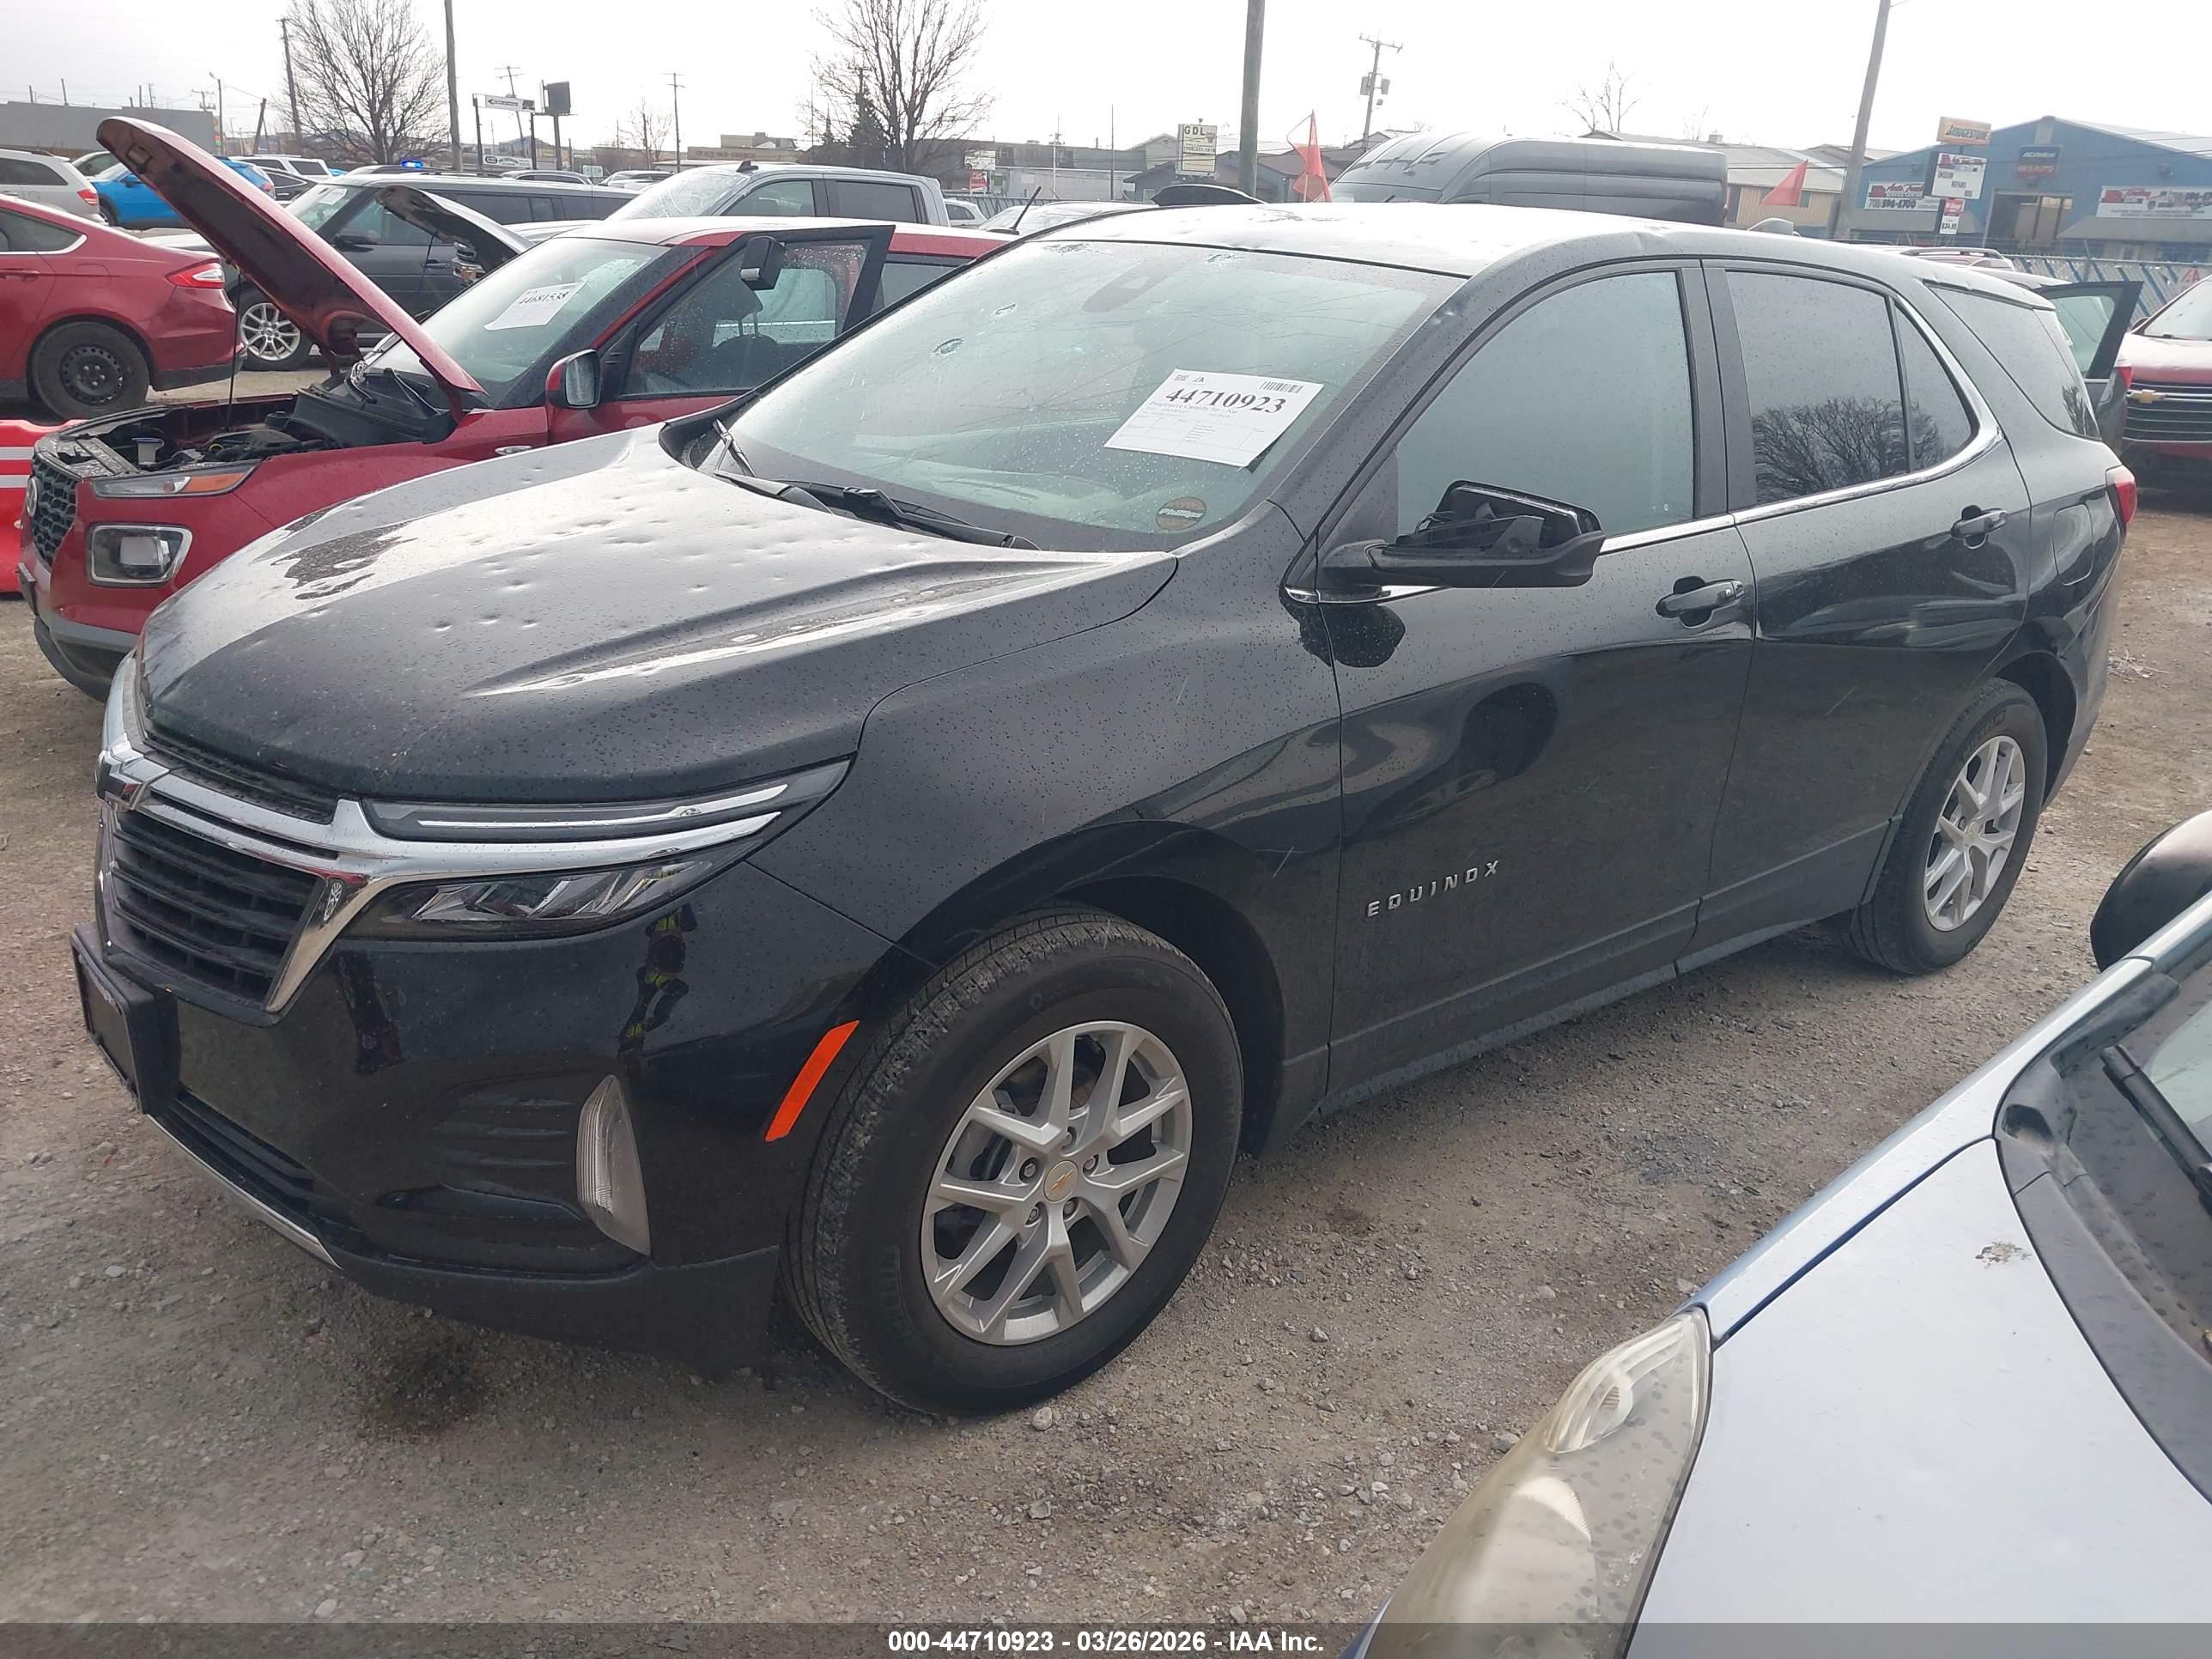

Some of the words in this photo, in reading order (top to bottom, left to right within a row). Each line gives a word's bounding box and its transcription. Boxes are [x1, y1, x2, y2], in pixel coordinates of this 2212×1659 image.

[1184, 125, 1206, 136] GDL
[1165, 387, 1287, 414] 44710923
[1366, 860, 1499, 918] EQUINOX
